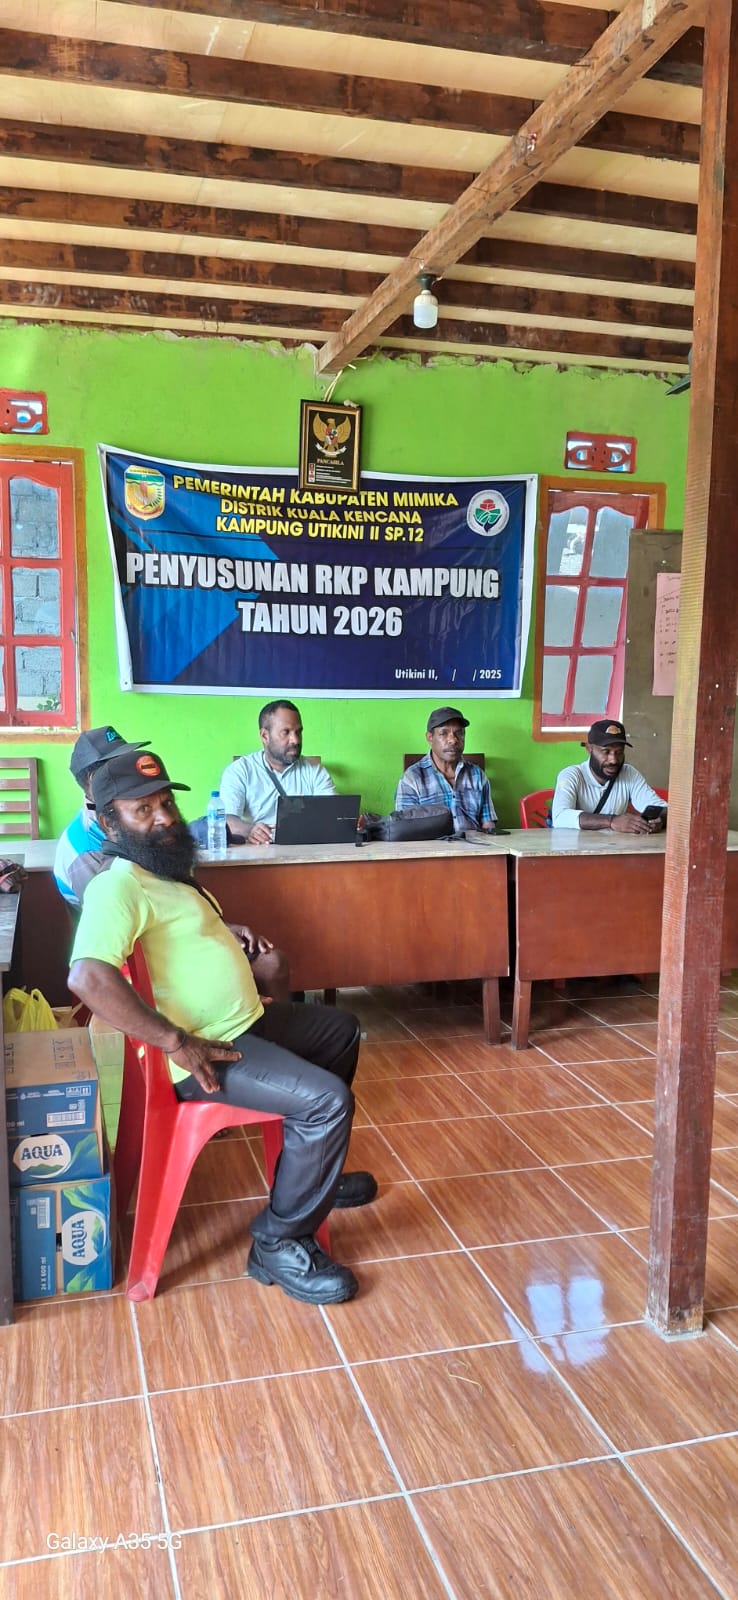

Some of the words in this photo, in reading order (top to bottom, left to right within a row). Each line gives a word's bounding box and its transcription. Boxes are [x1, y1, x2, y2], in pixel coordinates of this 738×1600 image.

[173, 475, 285, 504] PEMERINTAH
[289, 487, 389, 507] KABUPATEN
[393, 491, 459, 507] MIMIKA
[221, 499, 283, 517] DISTRIK
[287, 507, 340, 522] KUALA
[344, 509, 422, 524] KENCANA
[216, 516, 304, 537] KAMPUNG
[308, 522, 364, 540] UTIKINI
[369, 525, 379, 541] II
[384, 526, 424, 542] SP.12
[126, 552, 309, 594] PENYUSUNAN
[315, 564, 368, 596] RKP
[374, 567, 500, 599] KAMPUNG
[238, 601, 327, 635] TAHUN
[333, 606, 403, 637] 2026
[395, 668, 426, 679] Utikini
[479, 669, 502, 680] 2025
[21, 1144, 63, 1161] AQUA
[71, 1219, 88, 1258] AQUA
